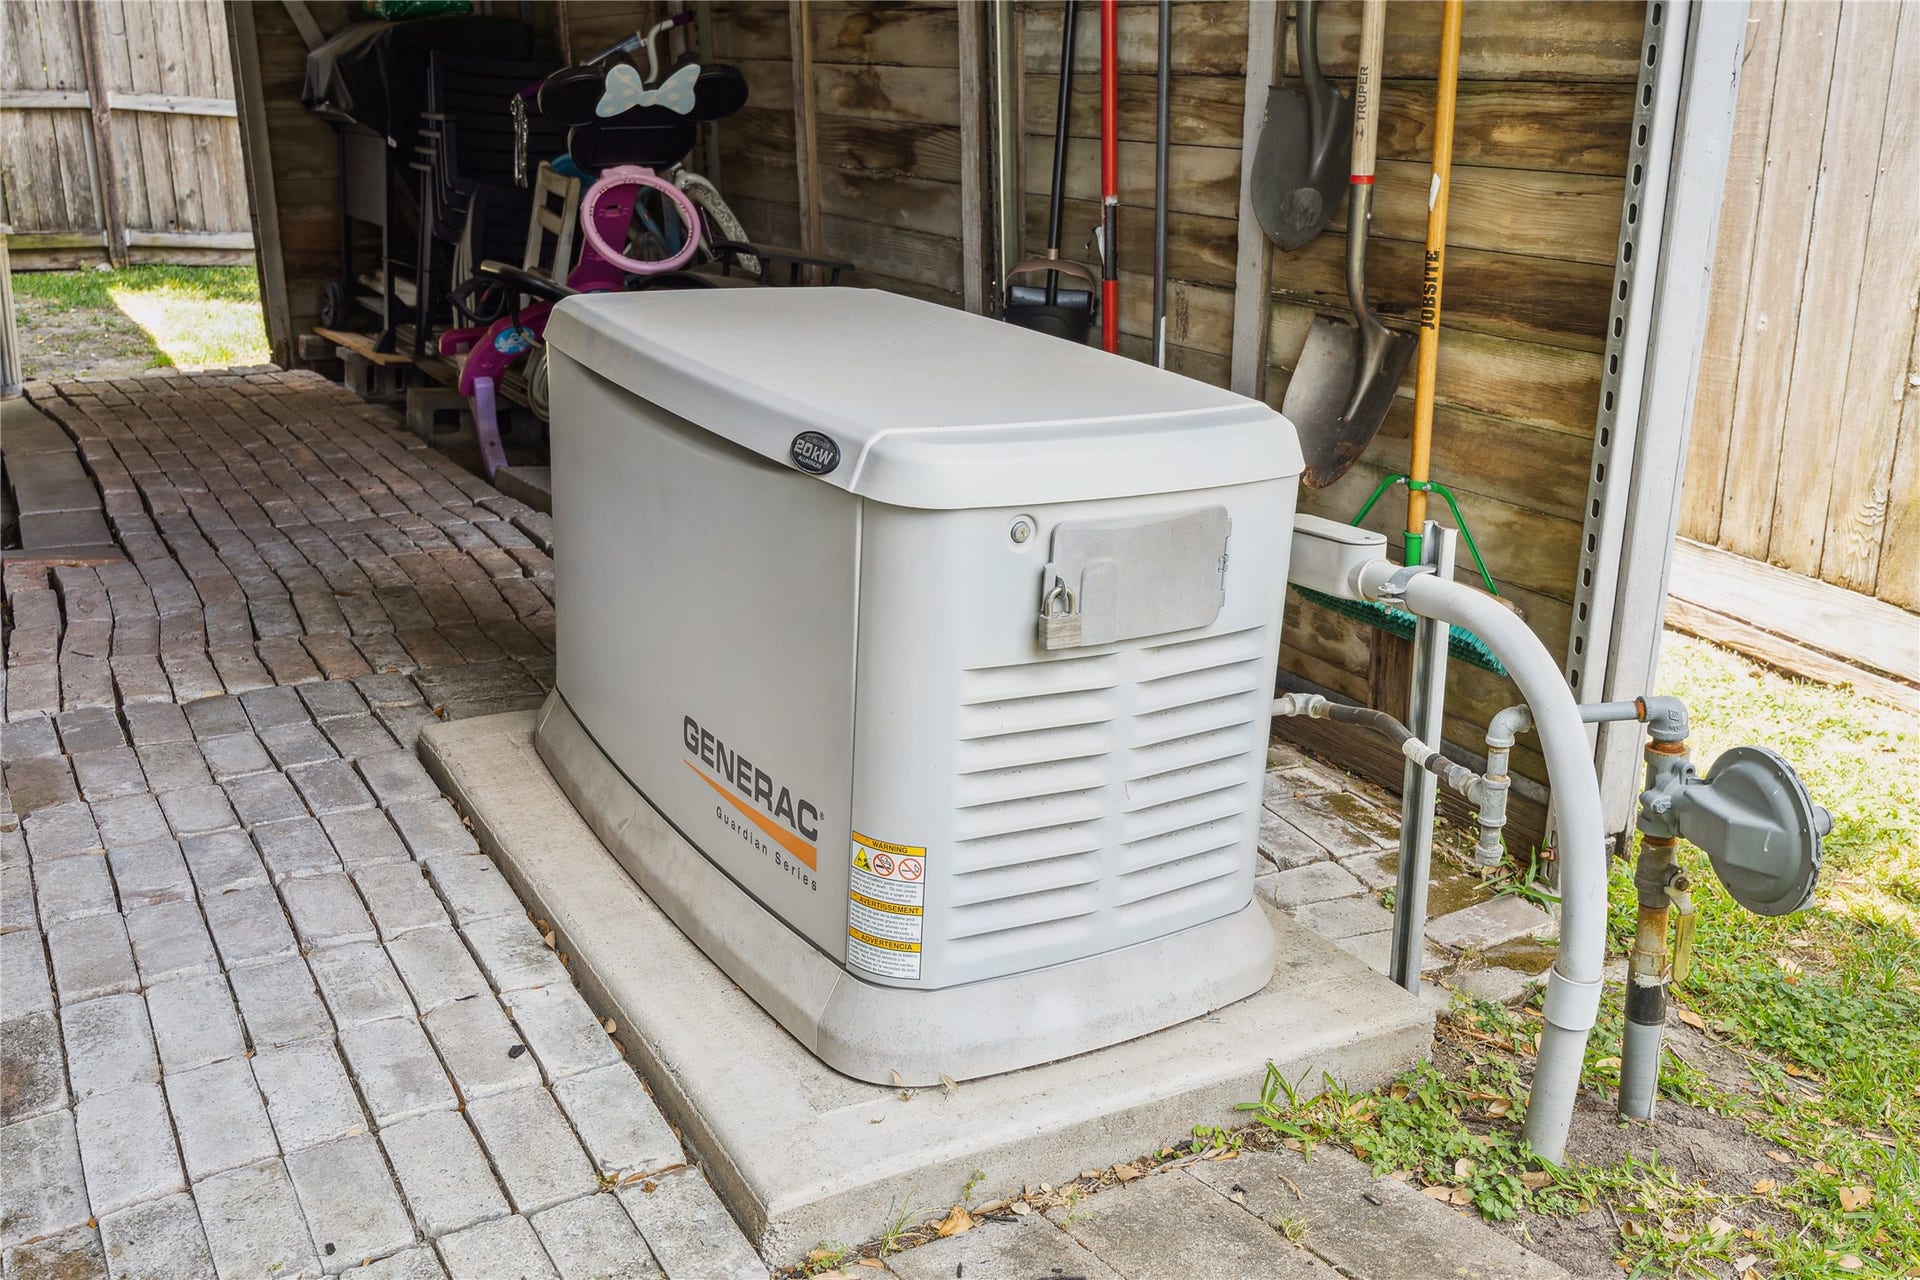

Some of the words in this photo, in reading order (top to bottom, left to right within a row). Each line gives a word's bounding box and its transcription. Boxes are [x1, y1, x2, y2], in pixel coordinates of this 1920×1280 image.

[1356, 66, 1369, 122] TRUPER
[1421, 250, 1440, 330] JOBSITE
[793, 438, 834, 465] 20kW
[683, 714, 819, 842] GENERAC
[716, 806, 768, 855] Guardian
[775, 851, 817, 891] Series
[871, 840, 908, 854] WARNING
[859, 897, 920, 914] AVERTISSEMENT
[861, 934, 913, 951] ADVERTENCIA
